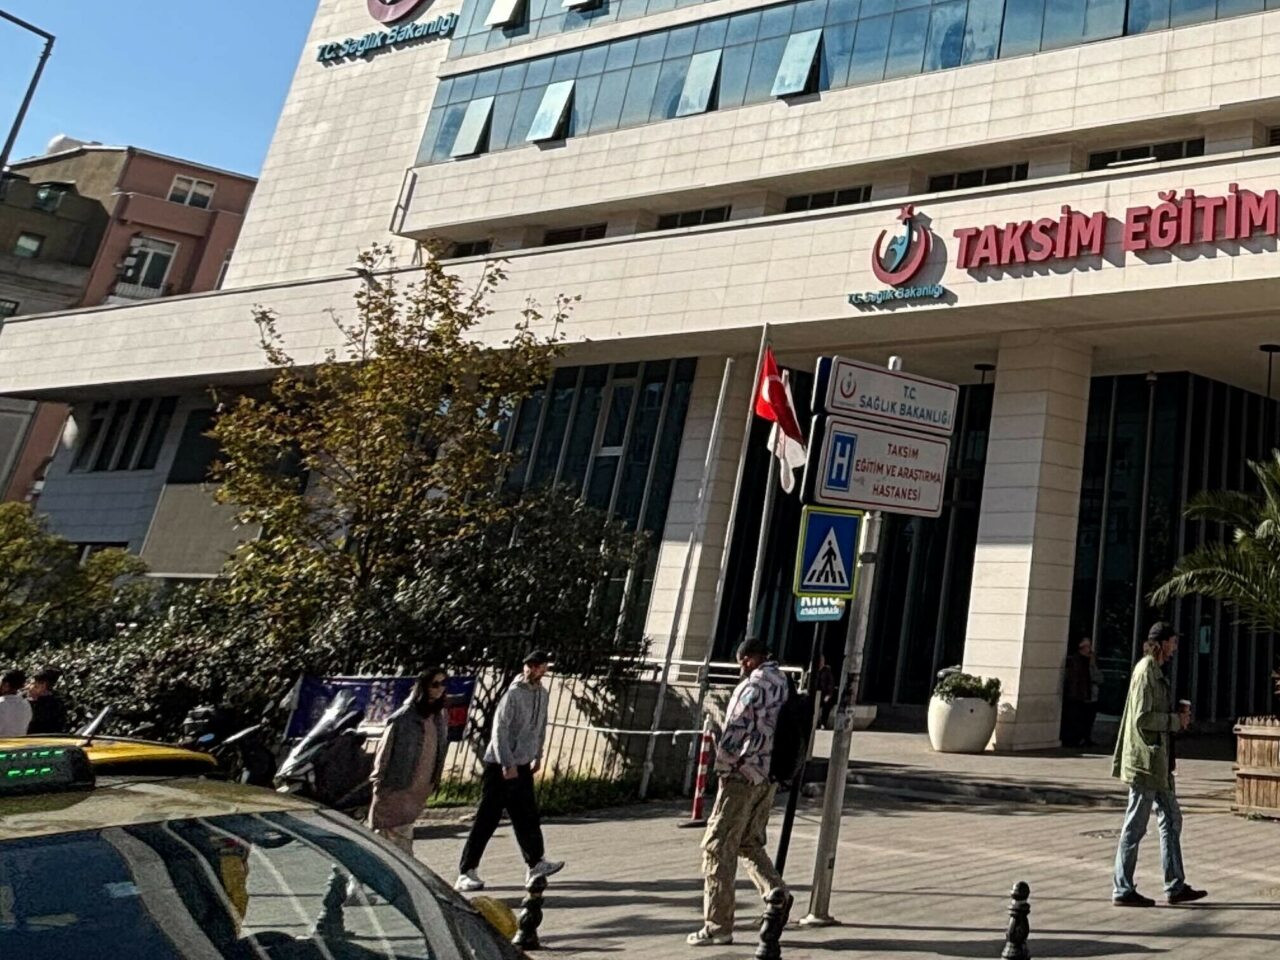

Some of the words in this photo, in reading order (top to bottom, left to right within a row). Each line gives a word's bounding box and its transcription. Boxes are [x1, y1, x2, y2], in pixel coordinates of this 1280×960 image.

[952, 205, 1106, 270] TAKSİM
[1121, 183, 1279, 252] EĞİTİM
[859, 395, 898, 413] SAĞLIK
[899, 403, 951, 425] BAKANLIĞI
[831, 442, 851, 481] H
[887, 443, 919, 460] TAKSİM
[855, 458, 884, 476] EĞİTİM
[886, 464, 898, 477] VE
[898, 467, 942, 484] ARAŞTIRMA
[872, 483, 921, 502] HASTANESİ
